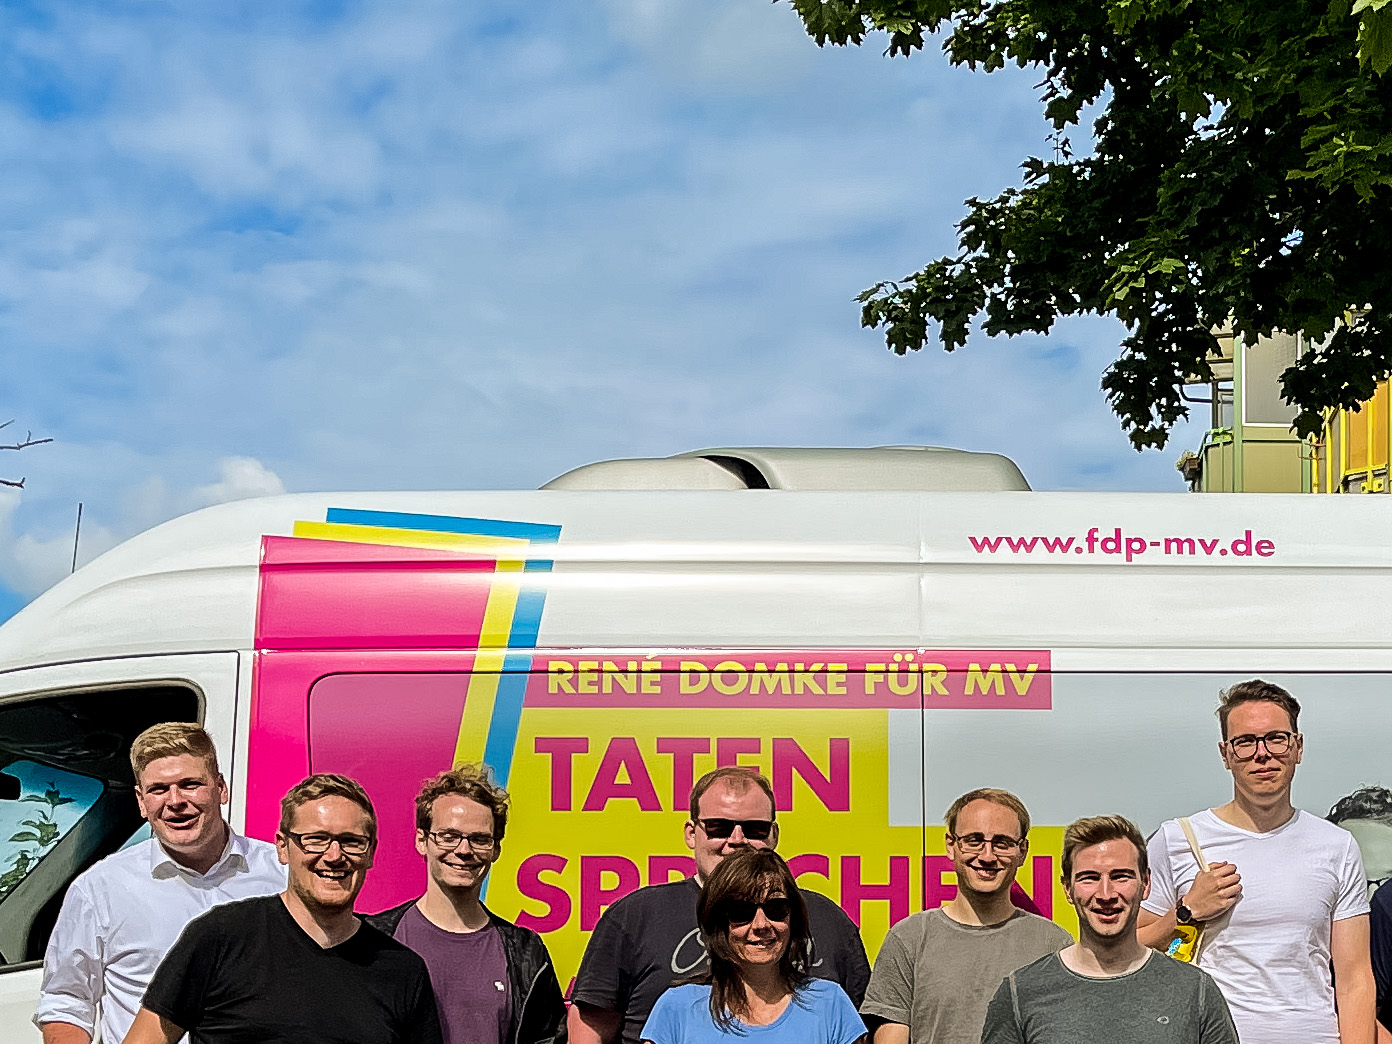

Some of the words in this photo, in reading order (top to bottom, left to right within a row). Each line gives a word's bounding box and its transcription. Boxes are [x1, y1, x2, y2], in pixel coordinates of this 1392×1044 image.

[968, 528, 1275, 562] www.fdp-mv.de
[548, 653, 663, 694] RENÉ
[679, 662, 847, 695] DOMKE
[864, 653, 949, 695] FÜR
[964, 663, 1038, 696] MV
